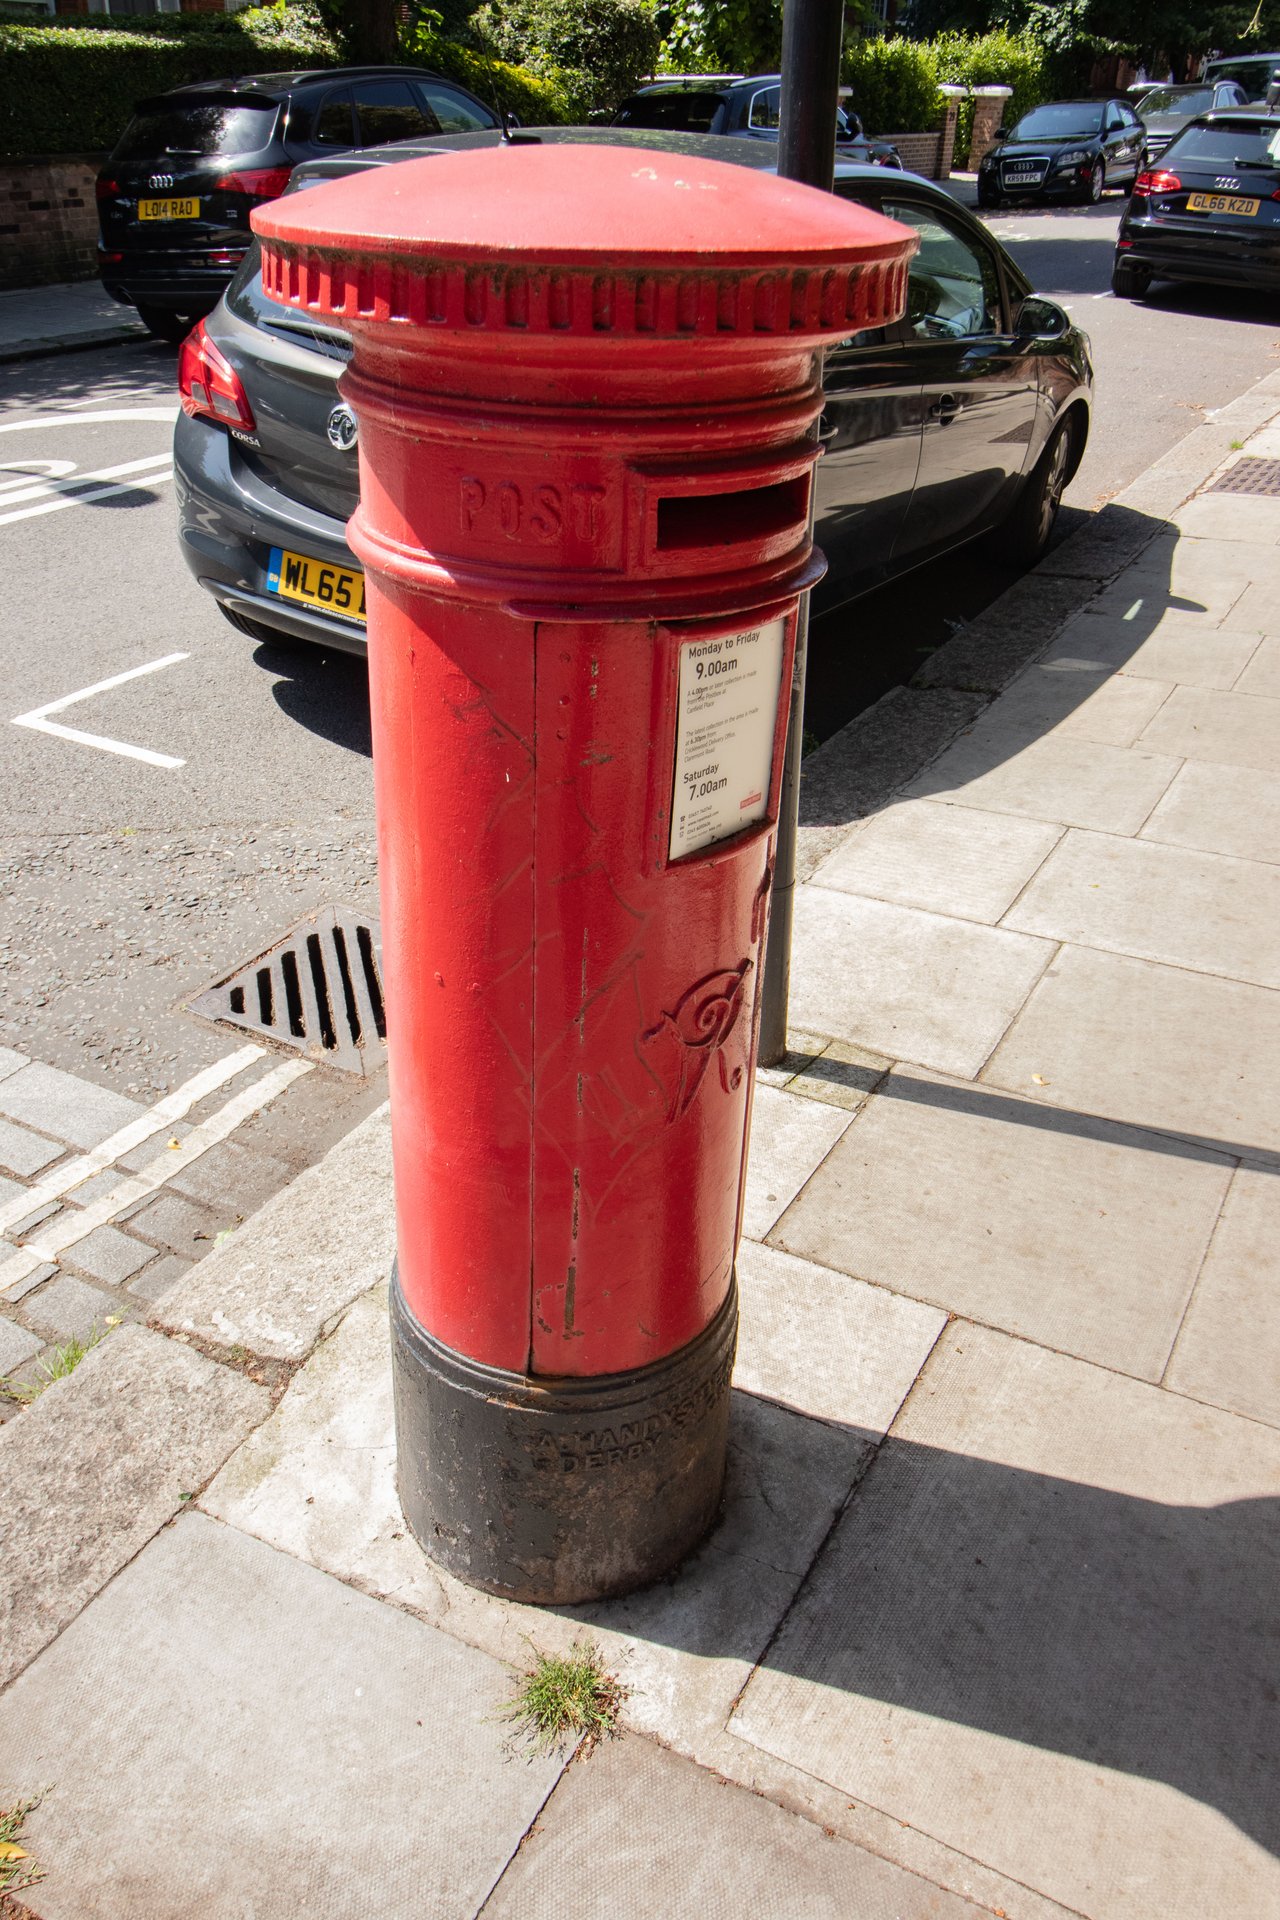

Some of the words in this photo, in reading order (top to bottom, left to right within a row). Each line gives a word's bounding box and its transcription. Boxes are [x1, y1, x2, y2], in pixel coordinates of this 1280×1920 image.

[1193, 195, 1225, 210] GL66
[1227, 199, 1254, 213] KZD
[231, 429, 261, 447] CORSA
[460, 475, 607, 543] POST
[285, 557, 354, 608] WL65
[688, 643, 723, 659] Monday
[725, 640, 734, 649] to
[736, 632, 761, 646] Friday
[696, 658, 738, 680] 9.00am
[683, 763, 720, 784] Saturday
[689, 777, 728, 801] 7.00am
[561, 1432, 663, 1473] DERBY
